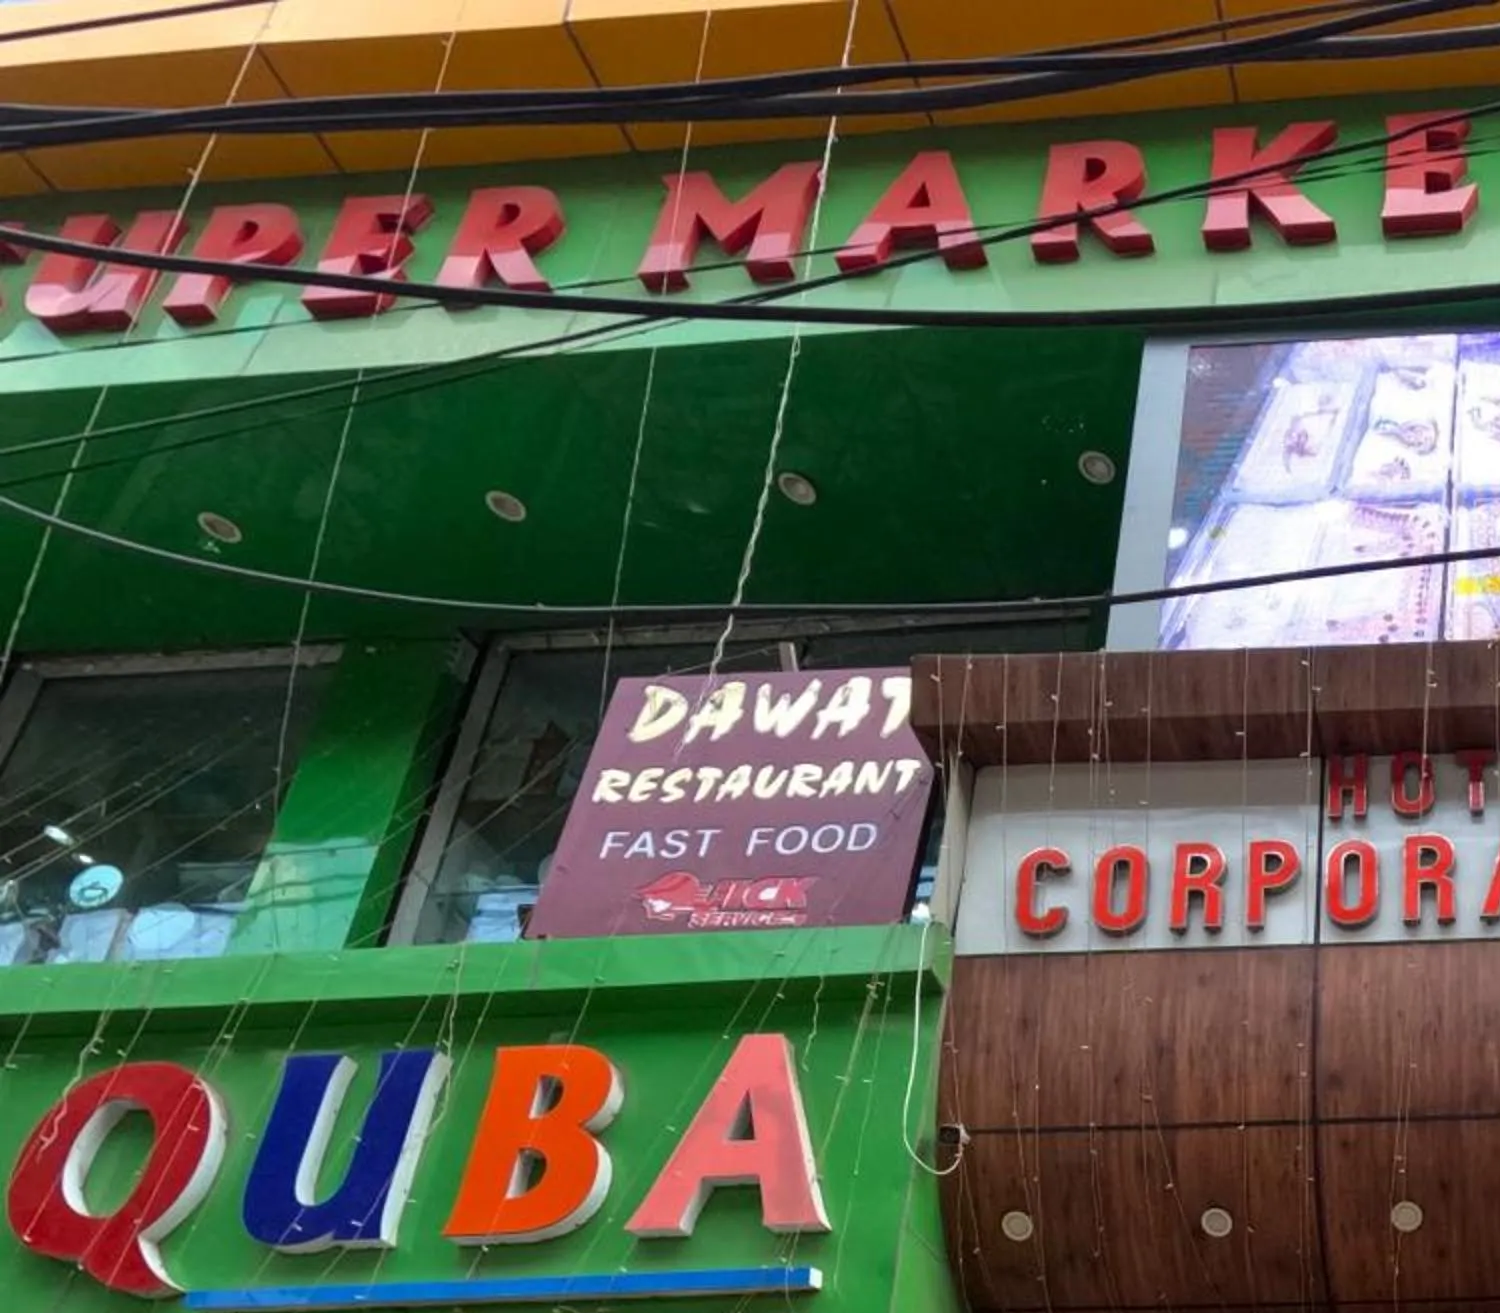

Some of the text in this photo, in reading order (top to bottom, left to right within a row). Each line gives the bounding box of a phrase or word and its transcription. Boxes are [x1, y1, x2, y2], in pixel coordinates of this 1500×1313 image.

[0, 184, 566, 335] UPER
[628, 676, 913, 744] DAWAT
[592, 759, 922, 803] RESTAURANT
[600, 823, 878, 860] FAST FOOD
[6, 1033, 834, 1298] QUBA
